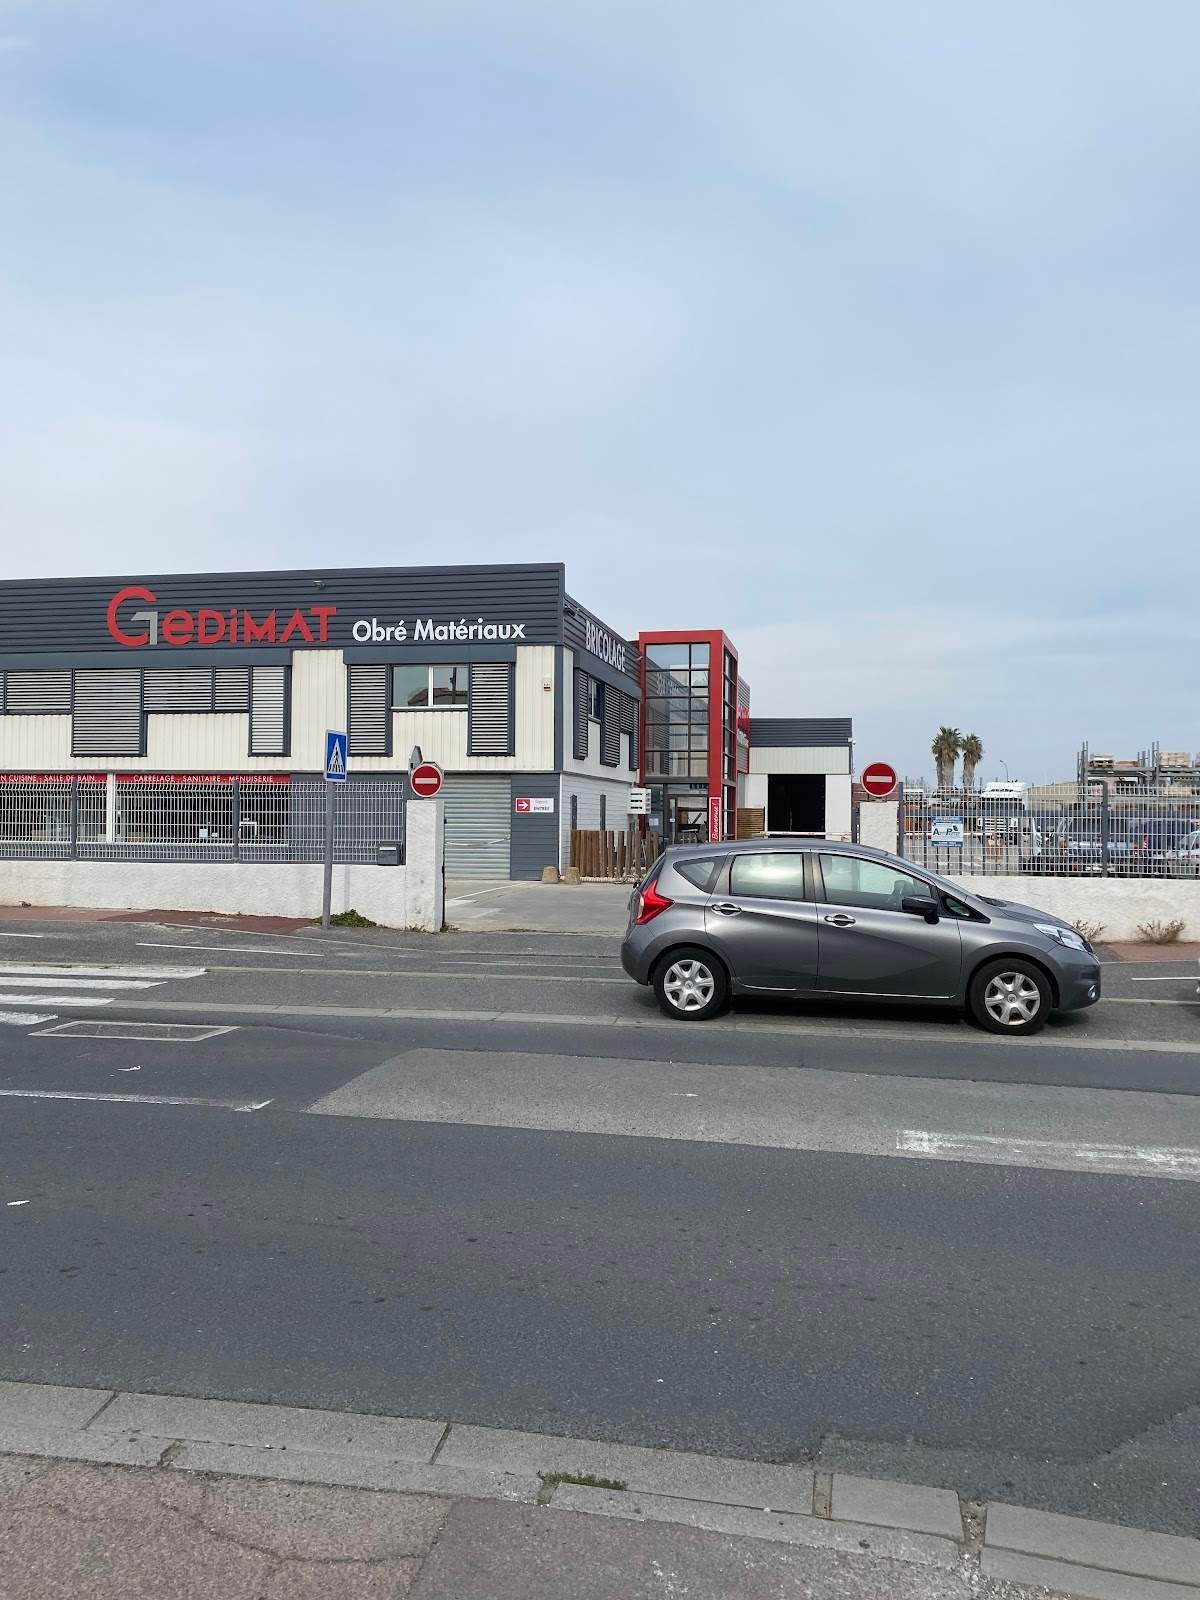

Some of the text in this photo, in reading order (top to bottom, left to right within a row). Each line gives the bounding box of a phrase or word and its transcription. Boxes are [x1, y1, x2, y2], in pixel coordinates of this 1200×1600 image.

[352, 617, 527, 642] Obré Matériaux
[585, 620, 626, 673] BRICOLAGE
[133, 775, 274, 783] CARRELAGE SANITAIRE MENUISERIE
